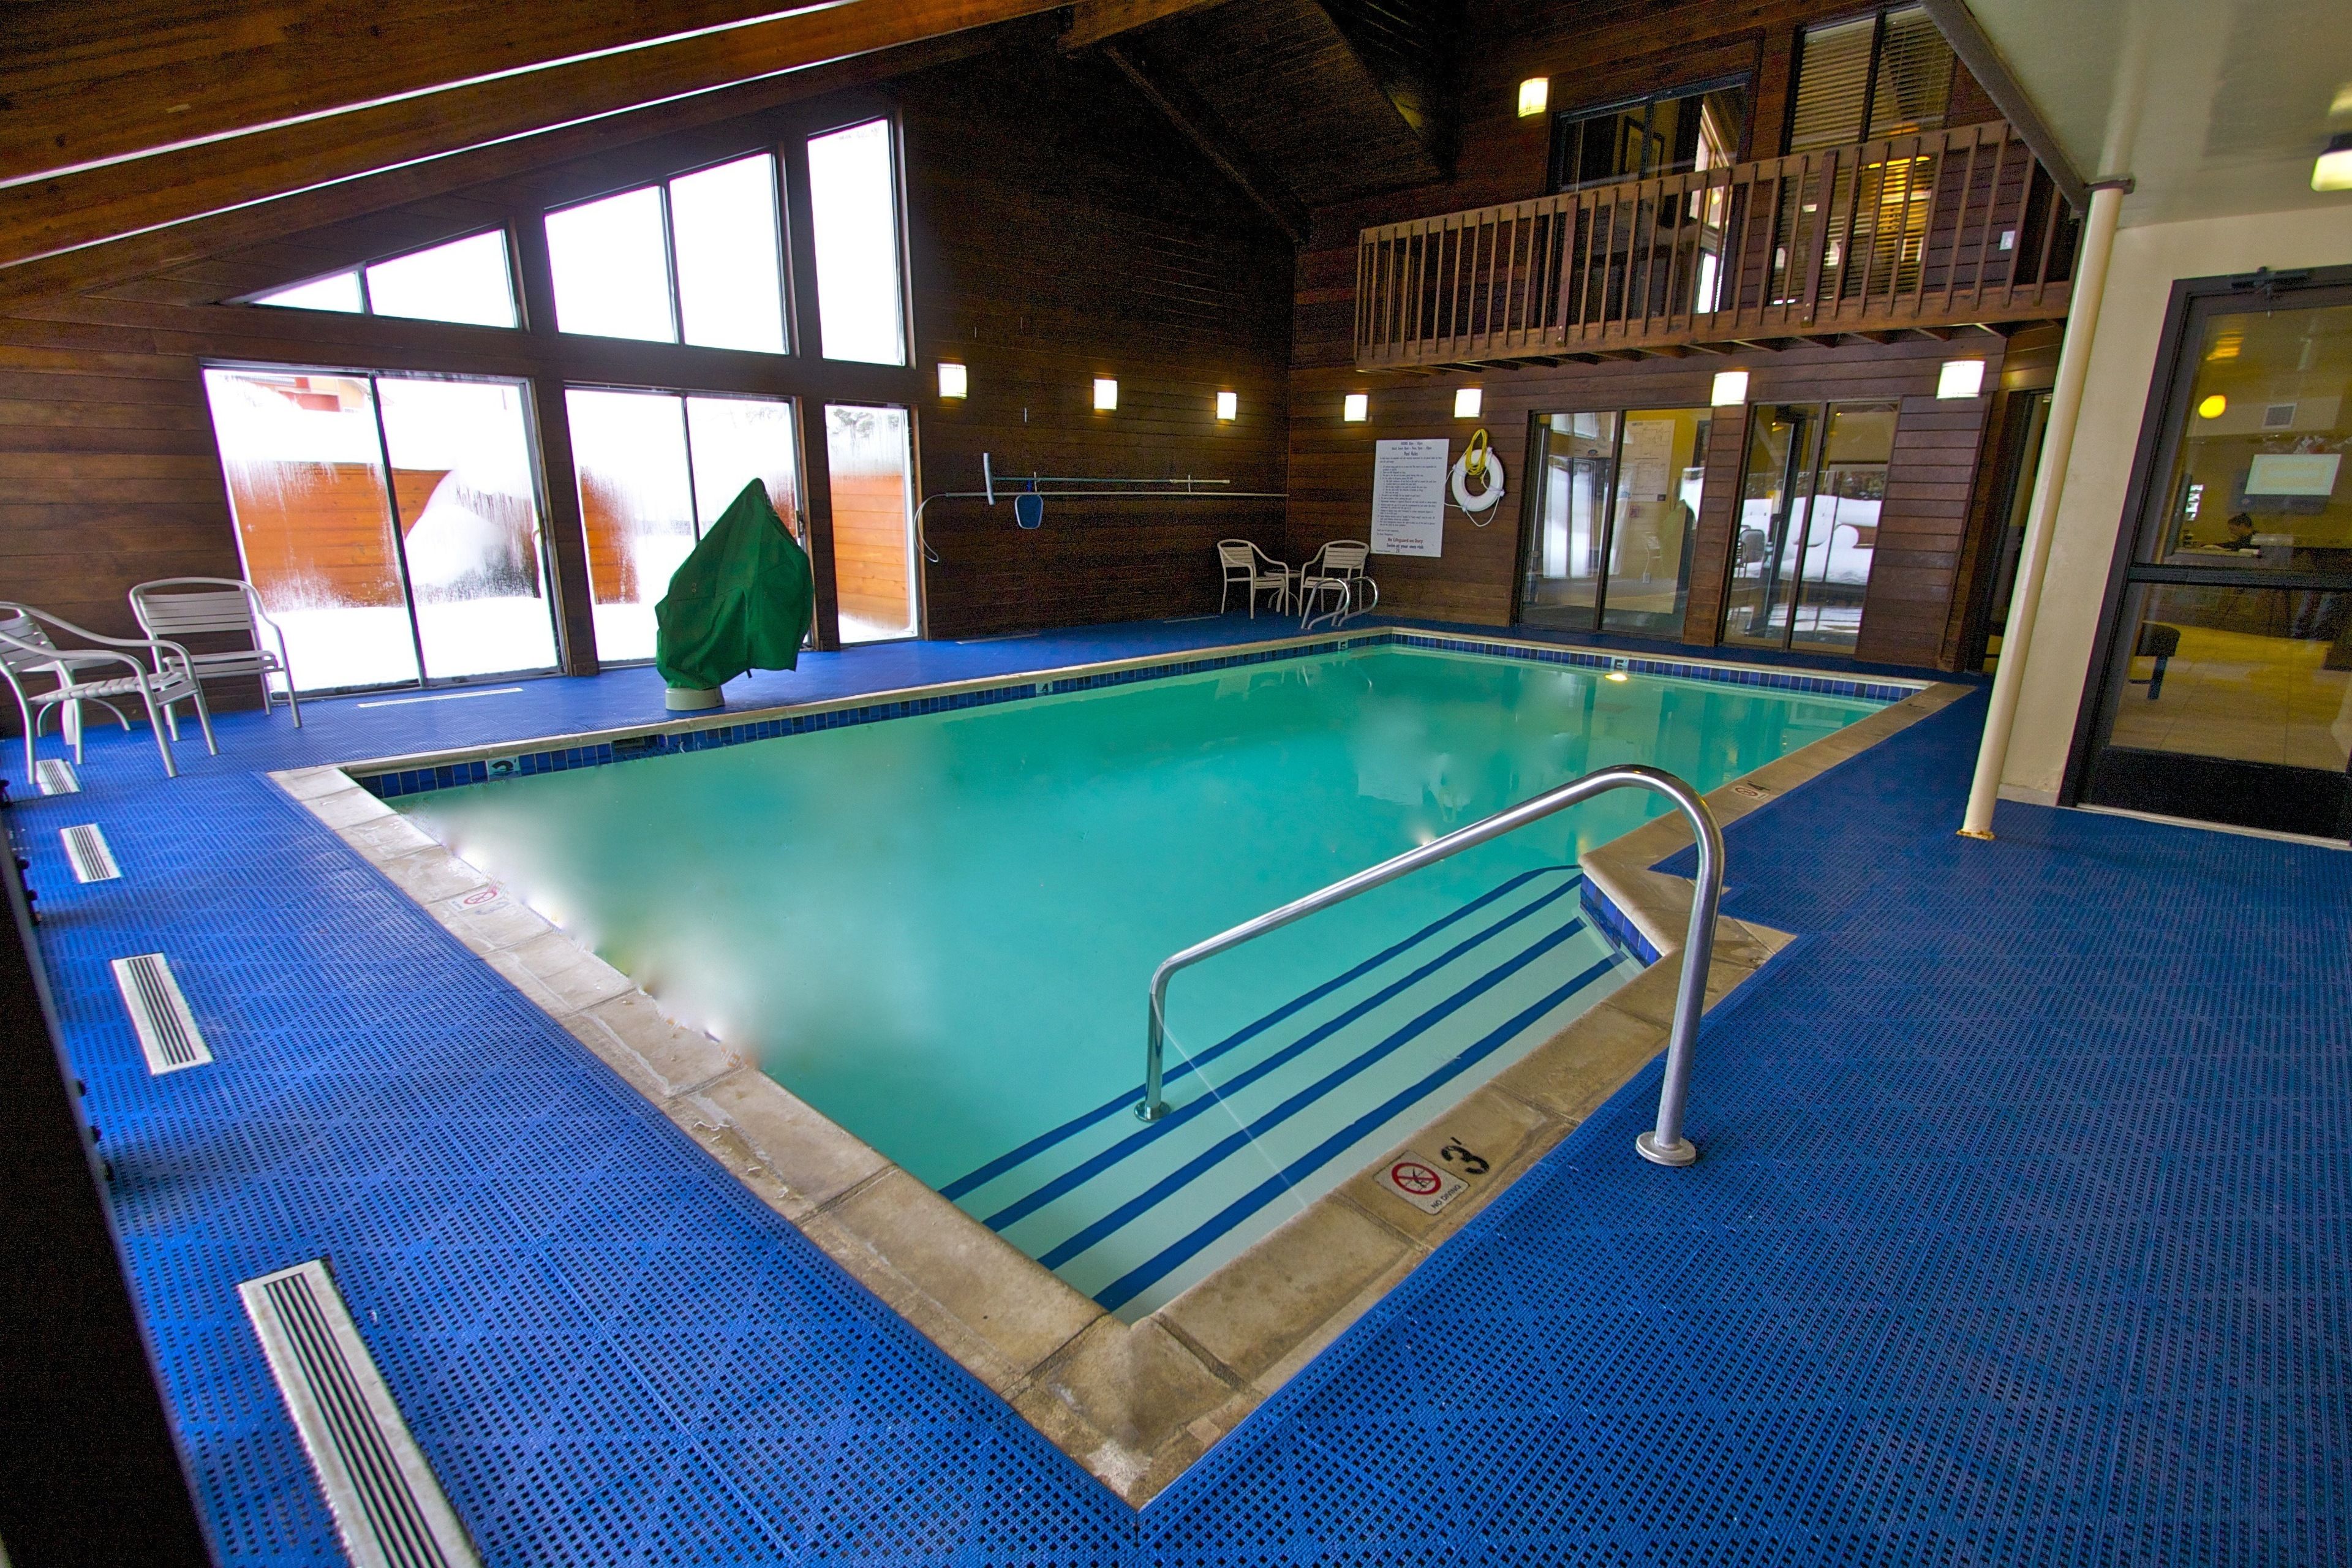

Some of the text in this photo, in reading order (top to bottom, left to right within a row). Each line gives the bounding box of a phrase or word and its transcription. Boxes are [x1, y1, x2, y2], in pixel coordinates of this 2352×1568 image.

[1441, 1136, 1490, 1175] 3'
[1430, 1185, 1461, 1208] NO DIVING
